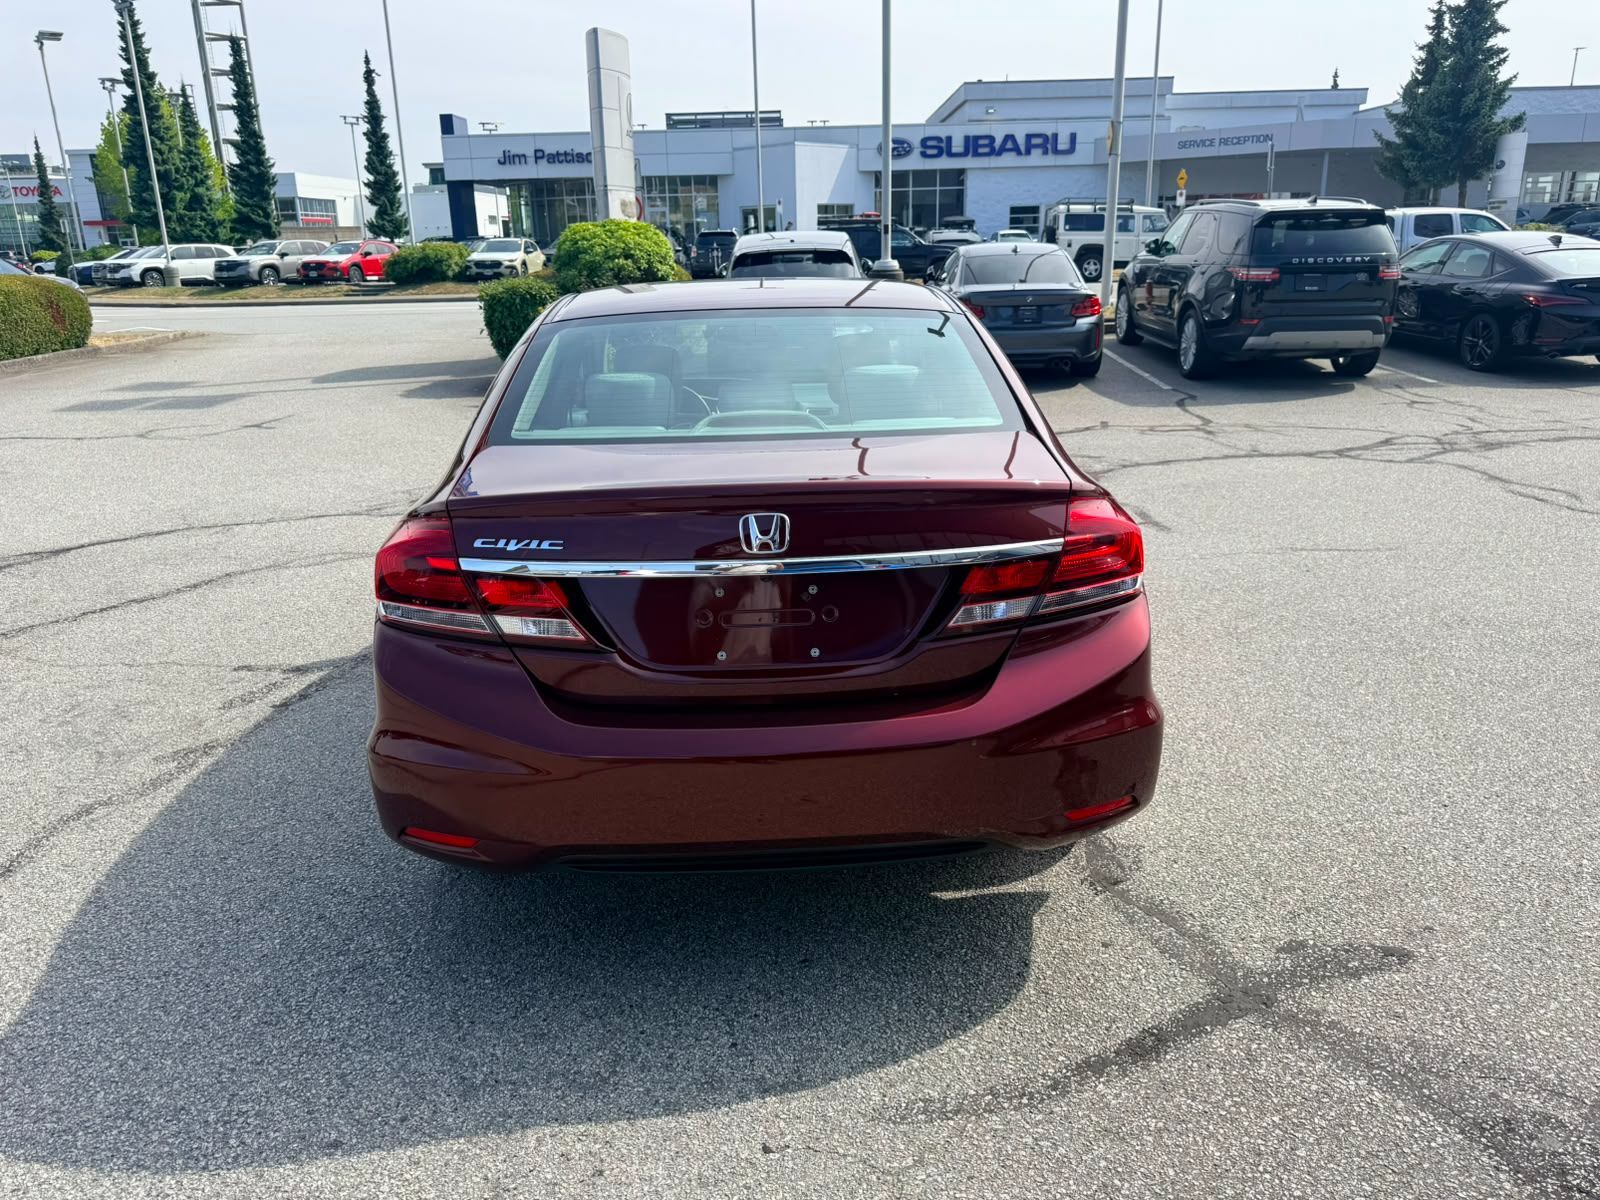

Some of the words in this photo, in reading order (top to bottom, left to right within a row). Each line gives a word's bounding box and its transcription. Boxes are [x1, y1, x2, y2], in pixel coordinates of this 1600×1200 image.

[919, 132, 1077, 159] SUBARU
[1177, 138, 1216, 150] SERVICE
[1218, 134, 1274, 147] RECEPTION
[497, 150, 527, 166] Jim
[534, 148, 593, 166] Pattiso
[11, 185, 63, 198] TOYA
[1292, 256, 1371, 264] DISCOVERY
[473, 538, 564, 551] CIVIC
